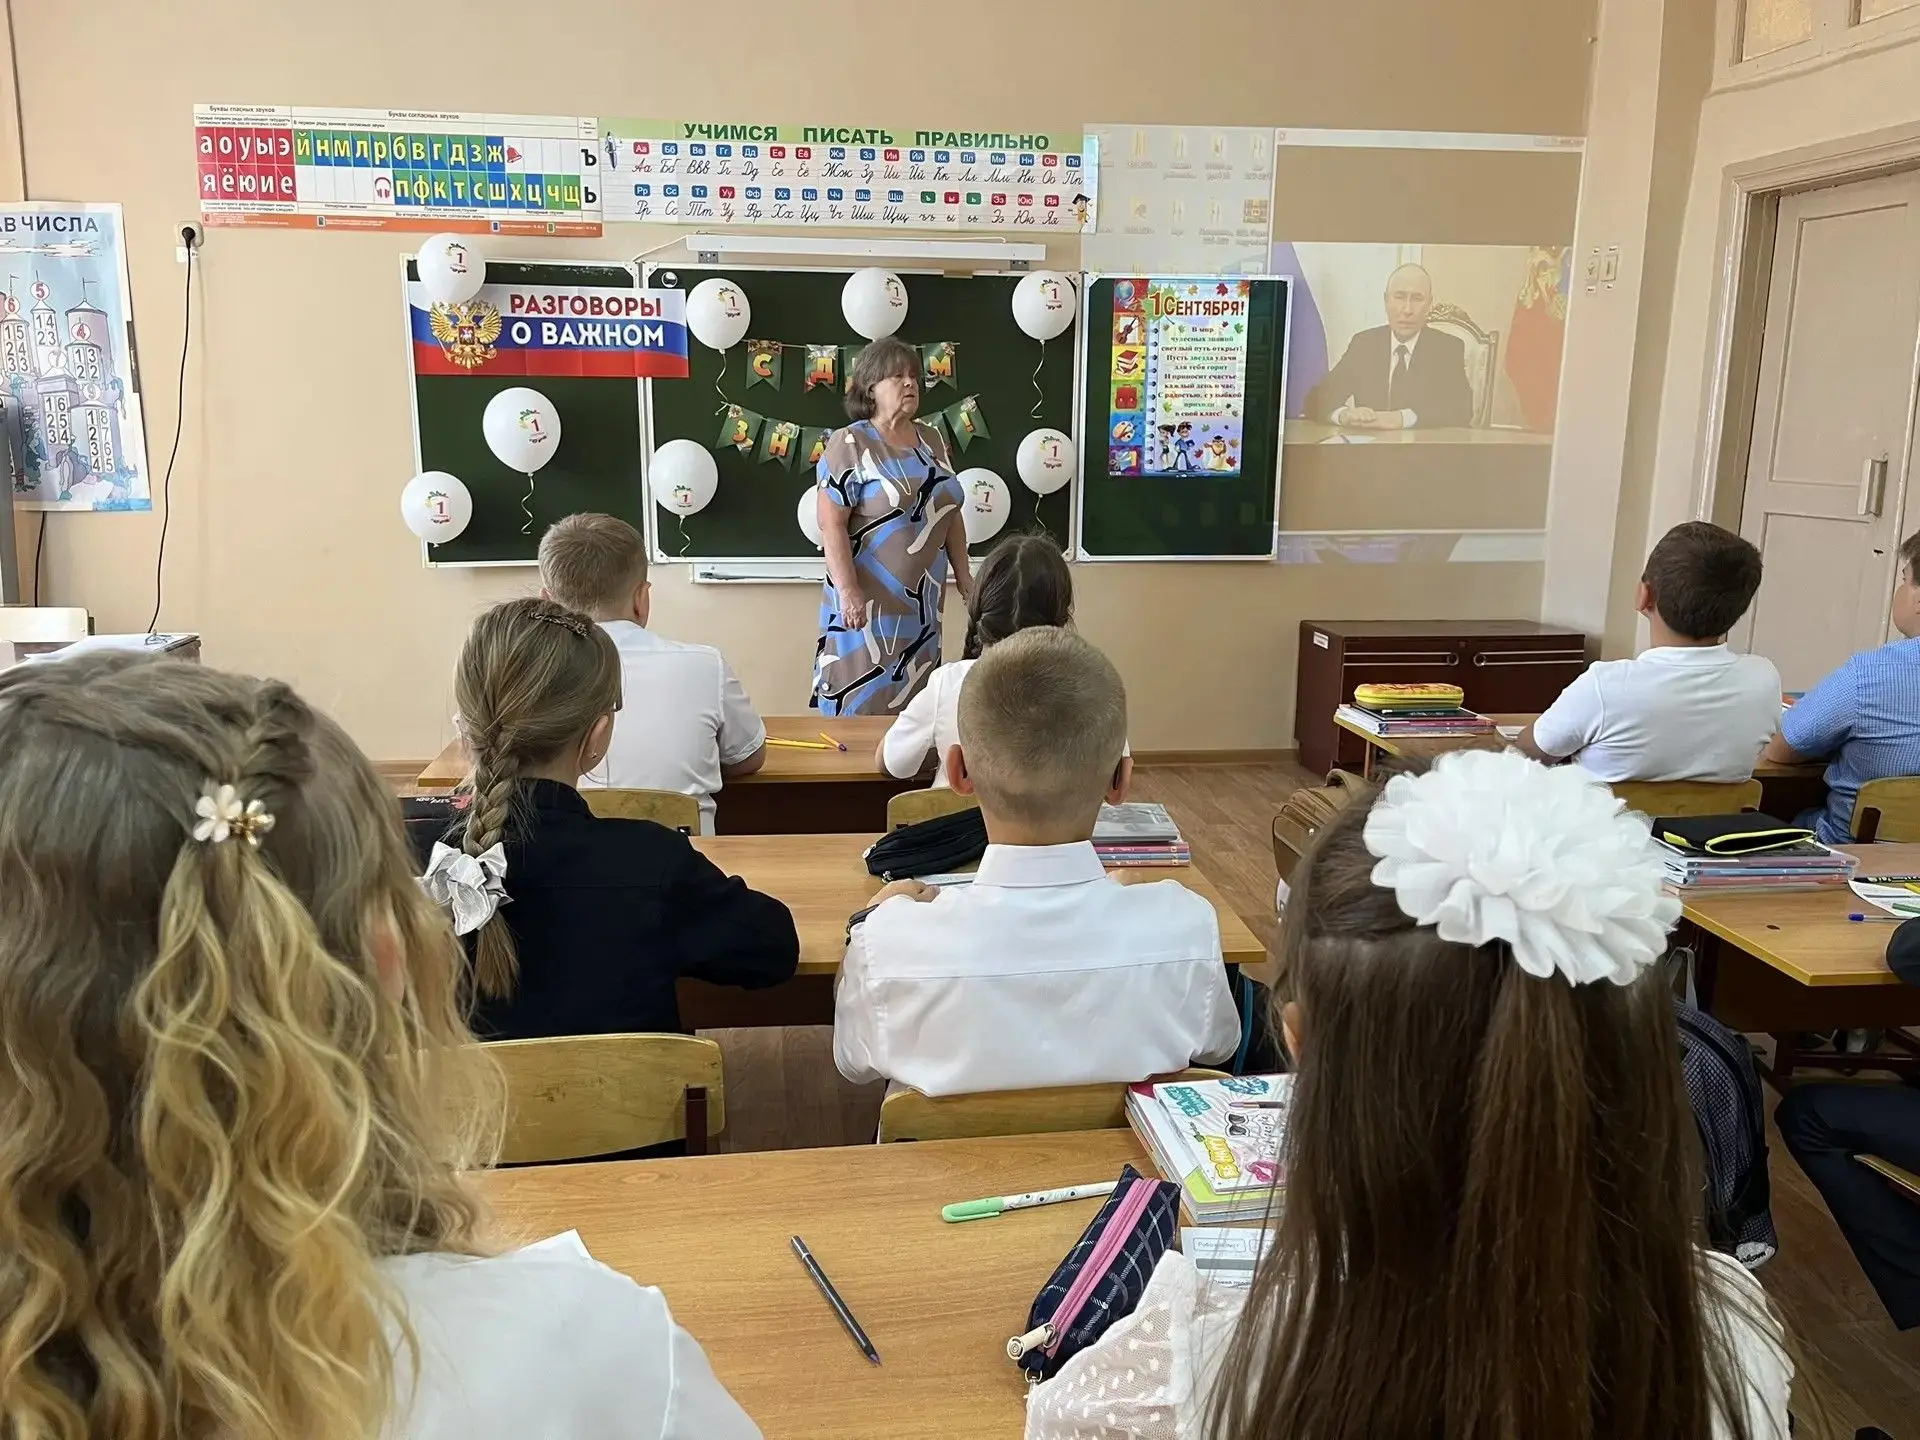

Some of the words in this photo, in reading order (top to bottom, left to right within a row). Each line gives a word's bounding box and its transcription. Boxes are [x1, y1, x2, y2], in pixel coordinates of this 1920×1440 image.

[684, 123, 778, 141] УЧИМСЯ
[803, 127, 894, 144] ПИСАТЬ
[915, 131, 1050, 150] ПРАВИЛЬНО
[201, 136, 212, 153] а
[220, 136, 232, 154] о
[239, 137, 251, 160] у
[256, 137, 273, 155] ы
[279, 138, 290, 155] э
[297, 132, 310, 155] й
[317, 140, 329, 156] н
[335, 140, 350, 157] м
[356, 141, 368, 158] л
[374, 141, 387, 165] р
[393, 136, 406, 160] б
[412, 143, 425, 160] в
[433, 144, 441, 160] г
[450, 144, 465, 166] д
[471, 144, 482, 162] з
[488, 145, 503, 162] ж
[204, 174, 216, 191] я
[222, 168, 235, 192] ё
[240, 175, 256, 192] ю
[261, 176, 274, 193] и
[281, 176, 293, 194] е
[396, 181, 408, 197] п
[414, 175, 429, 204] ф
[434, 181, 447, 198] к
[454, 182, 465, 199] т
[474, 183, 483, 199] с
[490, 184, 505, 200] ш
[510, 184, 521, 200] х
[528, 185, 541, 206] ц
[548, 185, 559, 201] ч
[564, 186, 580, 207] щ
[21, 216, 98, 232] ЧИСЛА
[36, 283, 45, 298] 5
[8, 298, 15, 312] 6
[510, 294, 661, 316] РАЗГОВОРЫ
[1149, 292, 1161, 315] 1
[1164, 296, 1244, 315] СЕНТЯБРЯ!
[36, 315, 42, 328] 1
[47, 315, 54, 328] 4
[5, 326, 10, 339] 1
[17, 326, 24, 339] 5
[38, 331, 45, 345] 2
[48, 332, 56, 345] 3
[77, 323, 86, 339] 4
[511, 322, 531, 345] О
[542, 322, 664, 347] ВАЖНОМ
[6, 342, 14, 355] 2
[19, 342, 26, 355] 4
[75, 349, 81, 362] 1
[88, 349, 96, 362] 3
[8, 357, 16, 371] 3
[21, 357, 28, 371] 3
[77, 365, 85, 378] 2
[90, 365, 98, 379] 2
[46, 398, 52, 410] 1
[58, 397, 65, 411] 6
[47, 414, 55, 428] 2
[60, 414, 67, 428] 5
[88, 411, 93, 424] 1
[101, 411, 108, 424] 8
[49, 429, 56, 443] 3
[61, 429, 69, 442] 4
[89, 427, 96, 440] 2
[102, 428, 109, 440] 7
[91, 442, 99, 456] 3
[104, 442, 111, 456] 6
[93, 458, 100, 471] 4
[105, 458, 113, 471] 5
